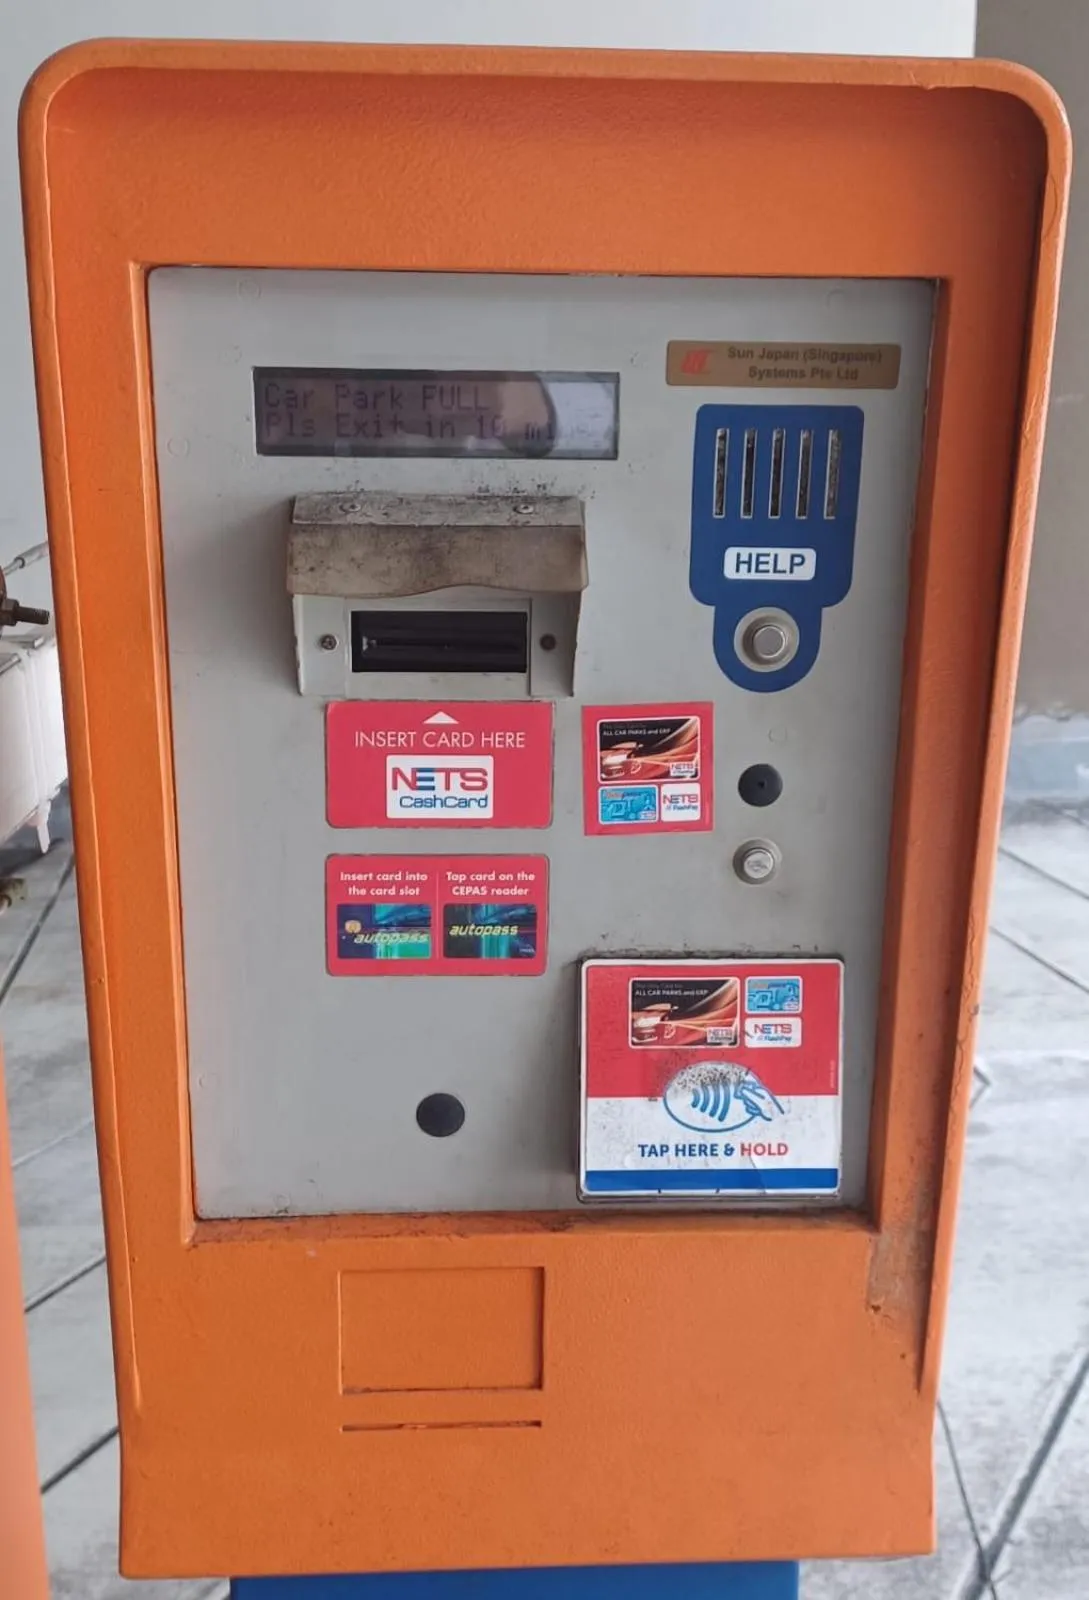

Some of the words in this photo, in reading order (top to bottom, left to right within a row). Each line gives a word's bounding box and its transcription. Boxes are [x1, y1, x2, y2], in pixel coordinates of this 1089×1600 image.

[727, 346, 754, 360] Sun
[758, 347, 798, 363] Japan
[802, 347, 883, 364] (Singapore)
[748, 366, 806, 381] Systems
[810, 367, 832, 380] Pte
[837, 367, 859, 381] Ltd
[264, 382, 315, 410] Car
[334, 383, 404, 411] Park
[421, 384, 491, 412] FULL
[265, 411, 317, 438] Pls
[335, 411, 404, 438] Exit
[424, 414, 456, 439] in
[735, 552, 806, 574] HELP
[355, 731, 417, 748] INSERT
[422, 731, 475, 748] CARD
[481, 731, 526, 748] HERE
[391, 767, 488, 791] NETS
[399, 794, 488, 809] CashCard
[662, 794, 699, 804] NETS
[340, 871, 373, 881] Insert
[376, 871, 402, 881] card
[405, 871, 428, 881] into
[446, 872, 466, 883] Tap
[470, 871, 496, 881] card
[499, 873, 513, 881] on
[517, 871, 535, 881] the
[348, 885, 365, 896] the
[370, 885, 396, 896] card
[399, 885, 420, 896] slot
[452, 886, 488, 896] CEPAS
[491, 886, 529, 896] reader
[449, 924, 518, 936] autopass
[353, 931, 429, 945] autopass
[754, 1023, 792, 1034] NETS
[638, 1143, 670, 1158] TAP
[674, 1143, 719, 1158] HERE
[723, 1144, 735, 1158] &
[740, 1142, 788, 1157] HOLD
